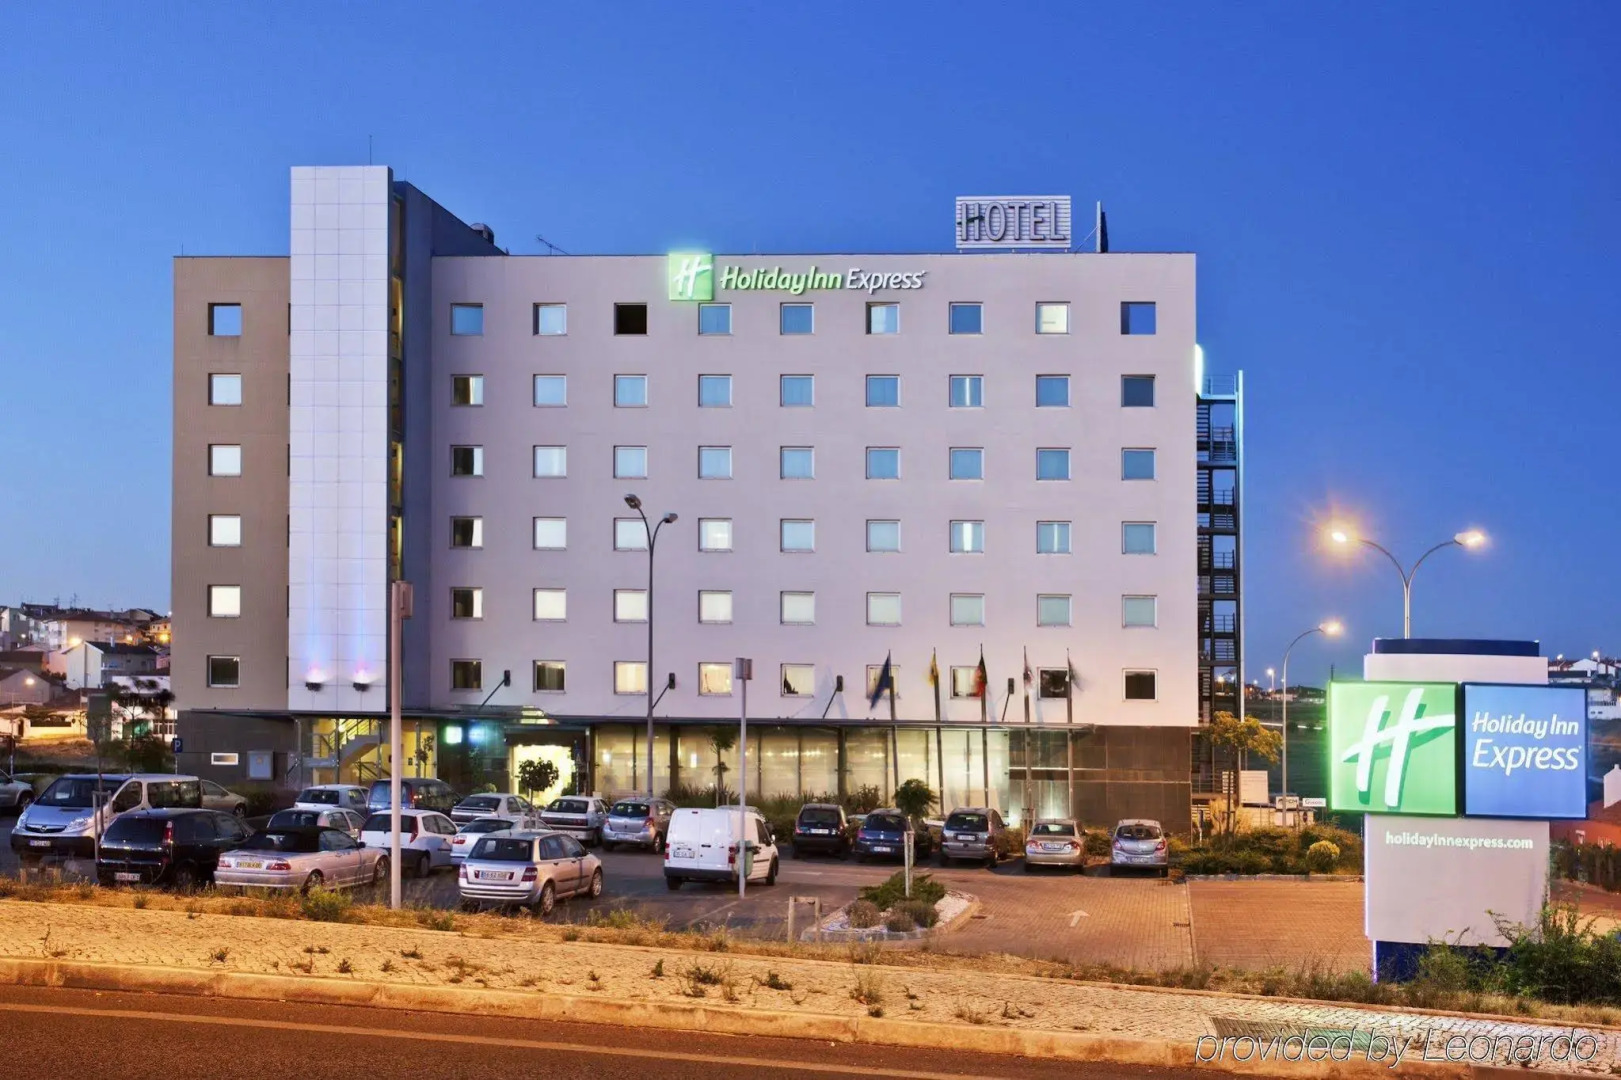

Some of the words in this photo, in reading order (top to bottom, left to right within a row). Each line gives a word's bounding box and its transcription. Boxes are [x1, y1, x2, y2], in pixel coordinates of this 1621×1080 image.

[957, 201, 1067, 241] HOTEL
[846, 267, 925, 295] Express
[1472, 711, 1549, 739] Holiday
[1550, 713, 1579, 736] Inn
[1472, 738, 1581, 777] Express
[1385, 830, 1534, 850] holidayinnexpress.com
